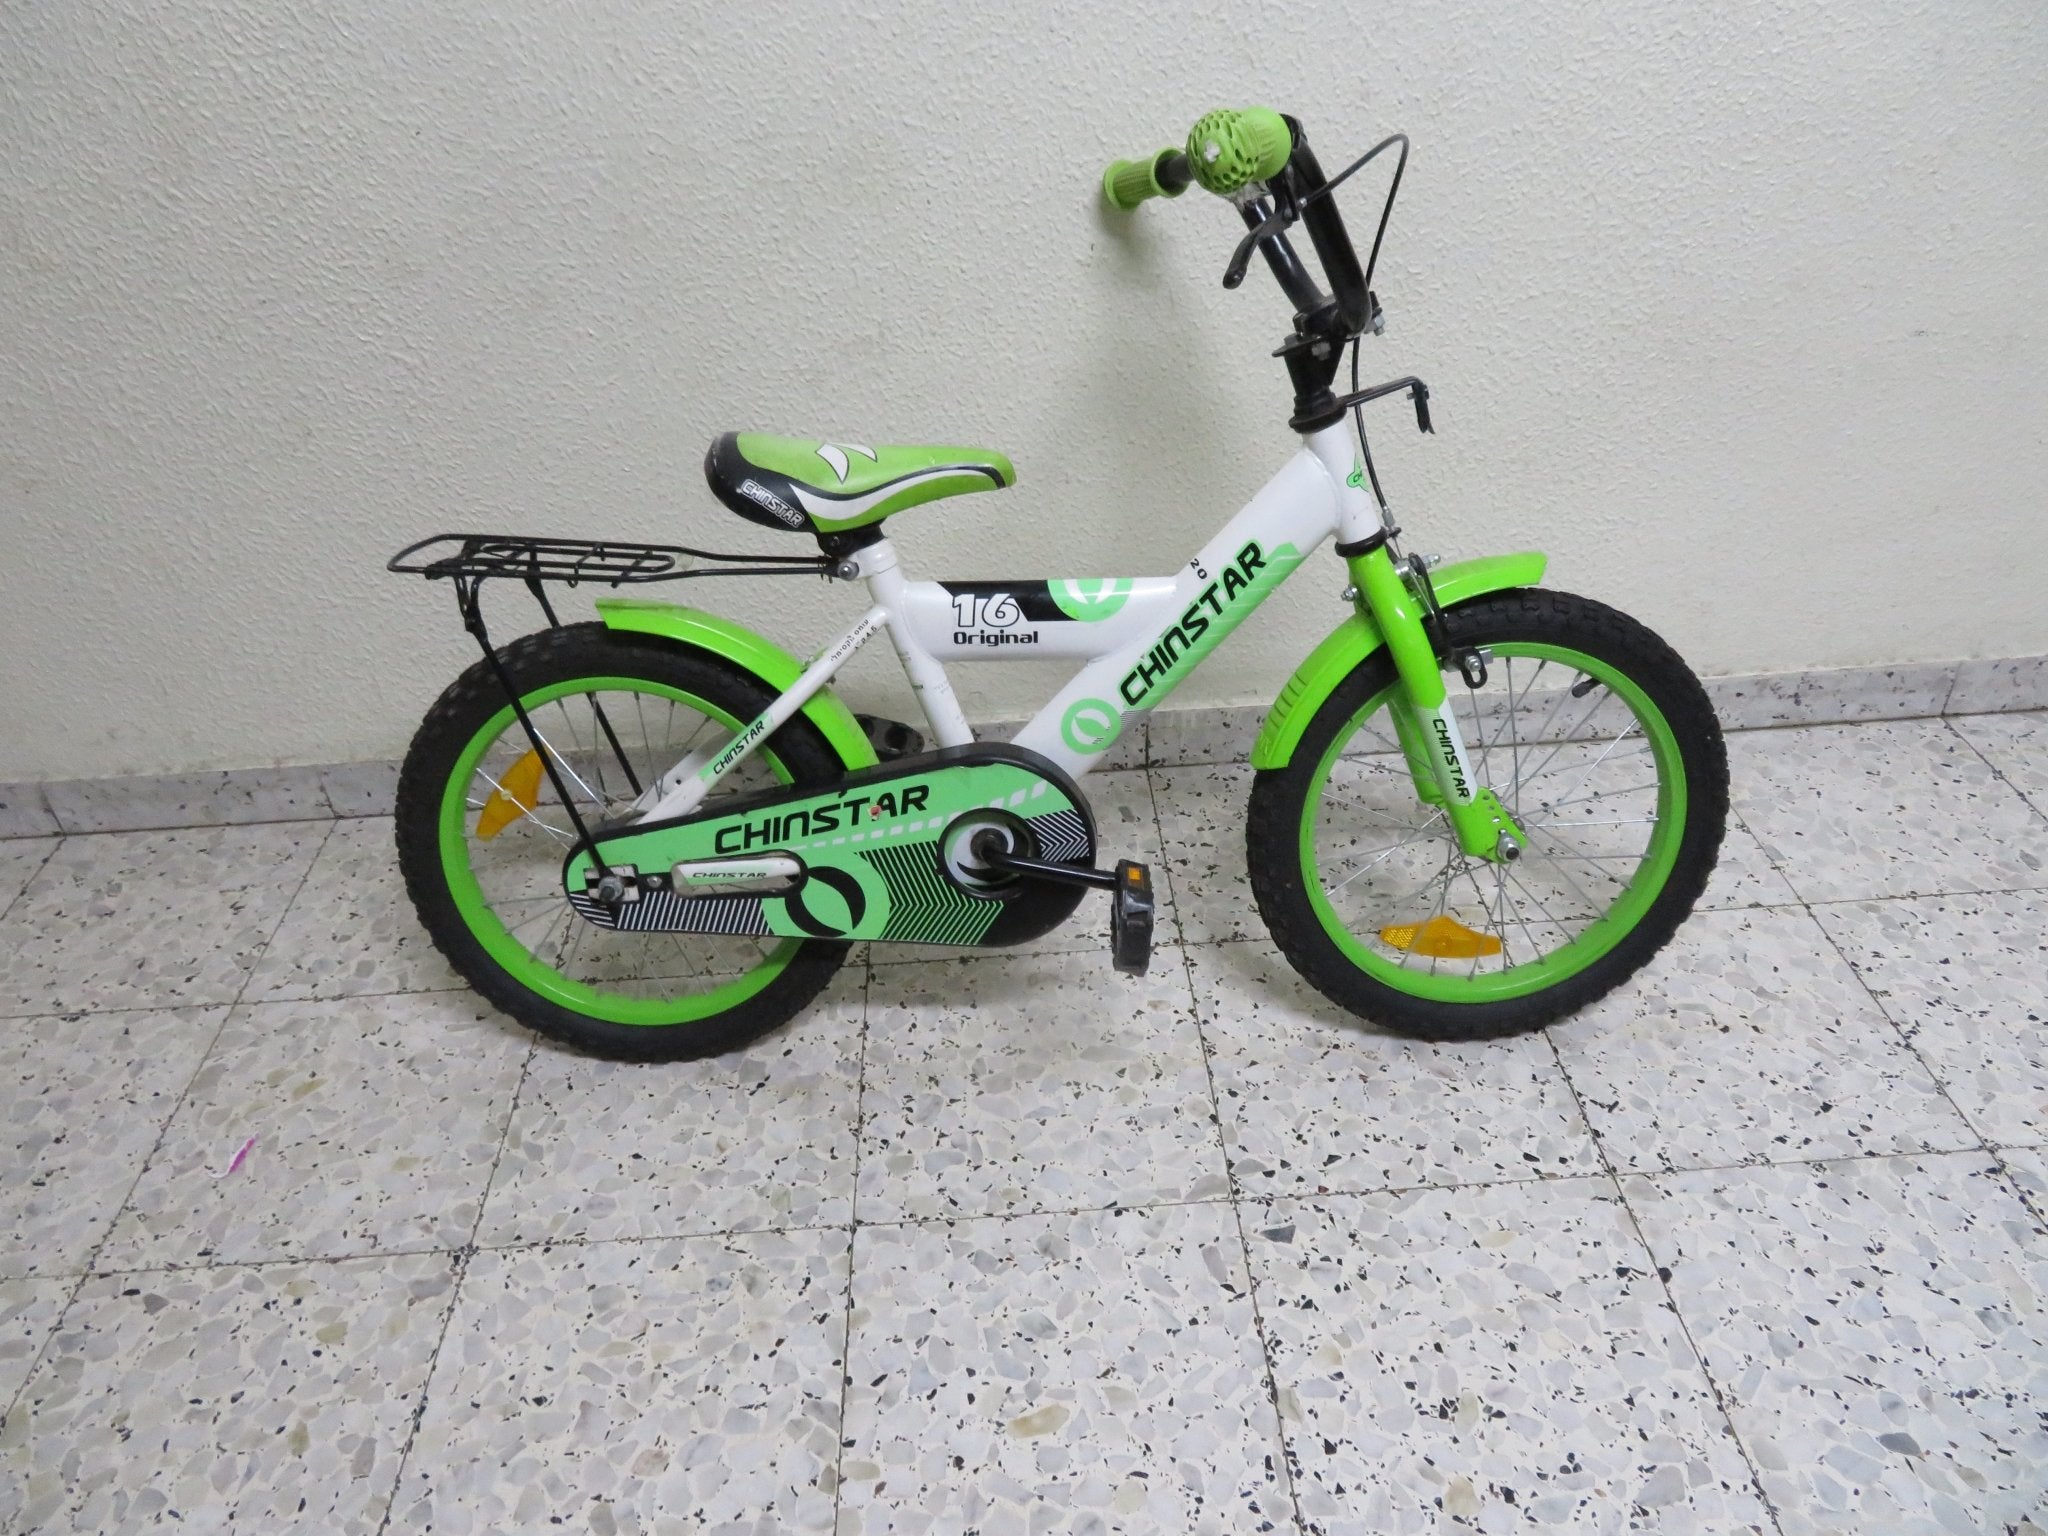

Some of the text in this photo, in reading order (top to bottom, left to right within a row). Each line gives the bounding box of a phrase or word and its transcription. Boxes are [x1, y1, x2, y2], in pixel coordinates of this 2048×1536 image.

[742, 480, 804, 526] CHINSTAR
[952, 593, 1020, 628] 16
[1120, 542, 1266, 706] CHINSTAR
[953, 629, 1039, 647] Original
[713, 720, 765, 774] CHINSTAR
[1432, 718, 1471, 798] CHINSTAR
[715, 785, 930, 854] CHINSTAR
